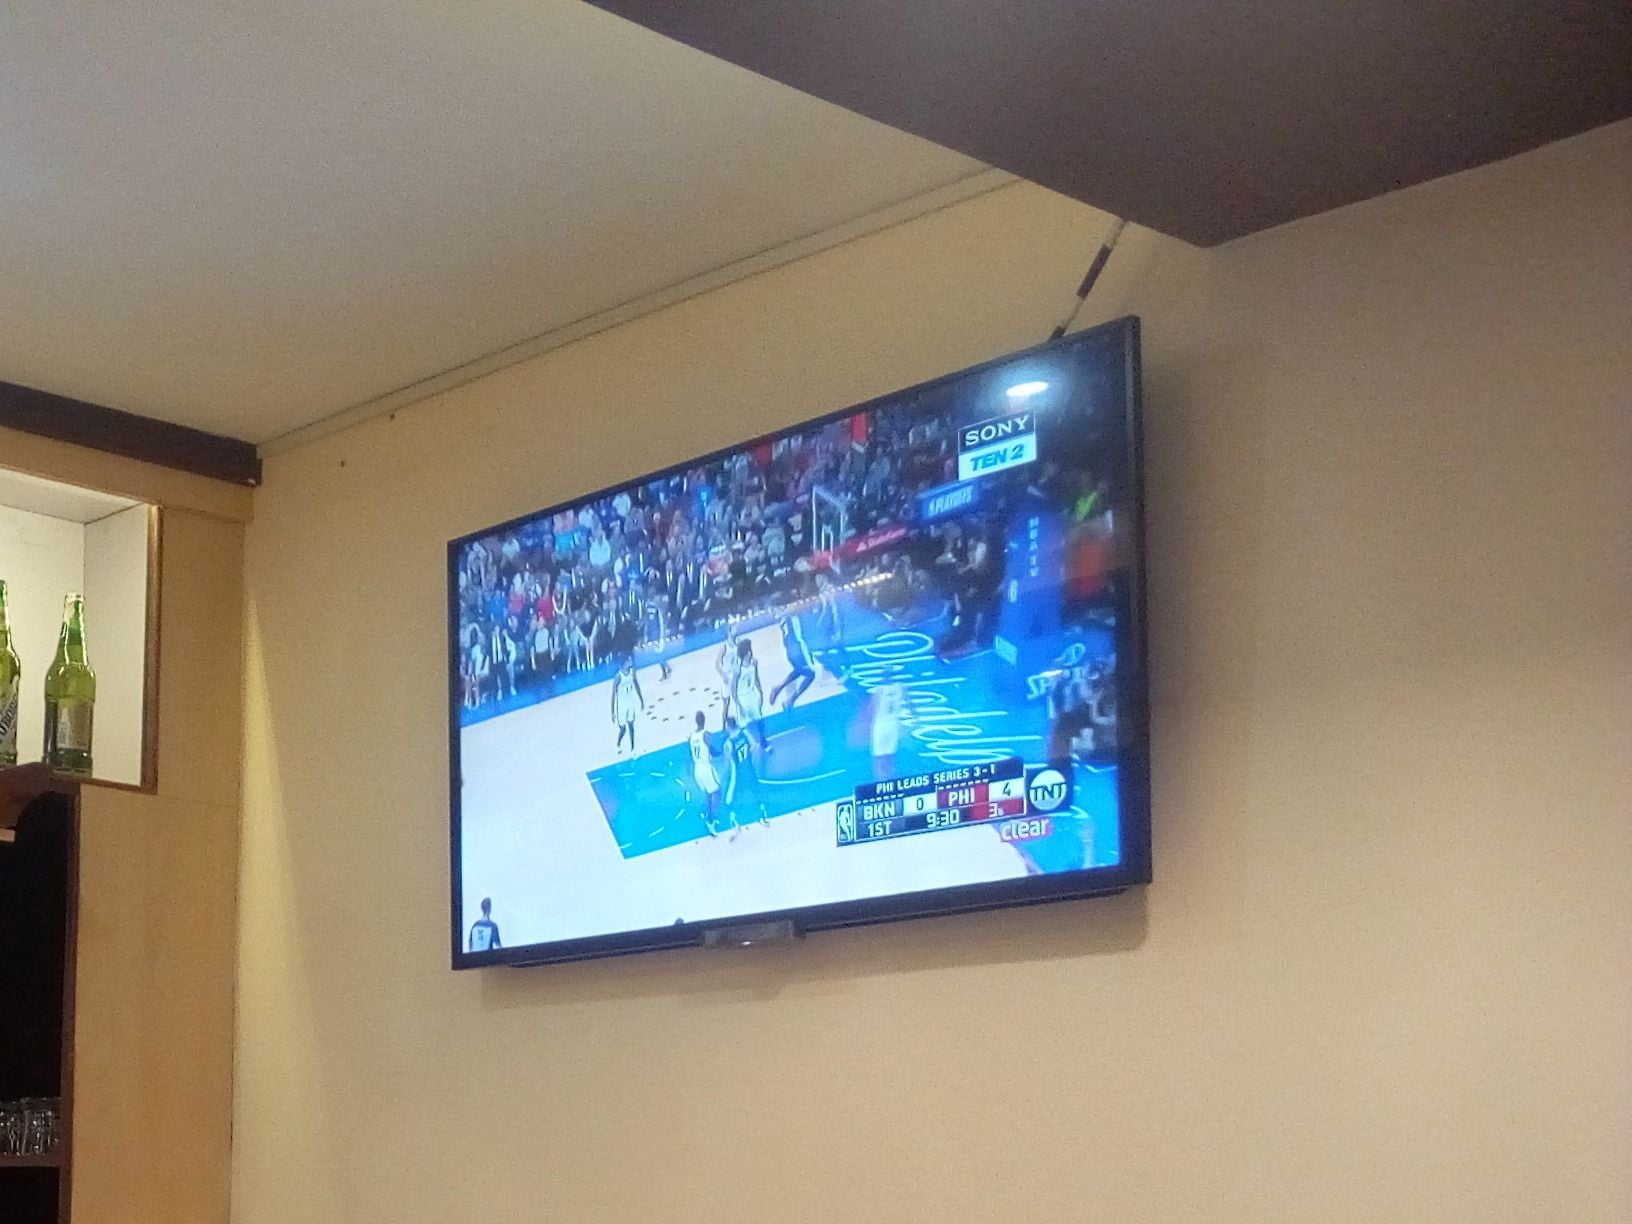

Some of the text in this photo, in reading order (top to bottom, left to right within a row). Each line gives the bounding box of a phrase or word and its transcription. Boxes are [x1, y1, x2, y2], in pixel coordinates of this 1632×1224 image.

[965, 415, 1029, 446] SONY
[970, 444, 1024, 471] TEN 2
[876, 781, 894, 795] PHI
[897, 773, 929, 790] LEADS
[933, 768, 969, 785] SERIES
[948, 782, 1011, 807] PHI 4
[1029, 782, 1067, 801] TNT
[863, 797, 924, 821] BKN 0
[867, 820, 892, 837] 1ST
[926, 809, 960, 828] 9:30
[1000, 817, 1050, 841] clear
